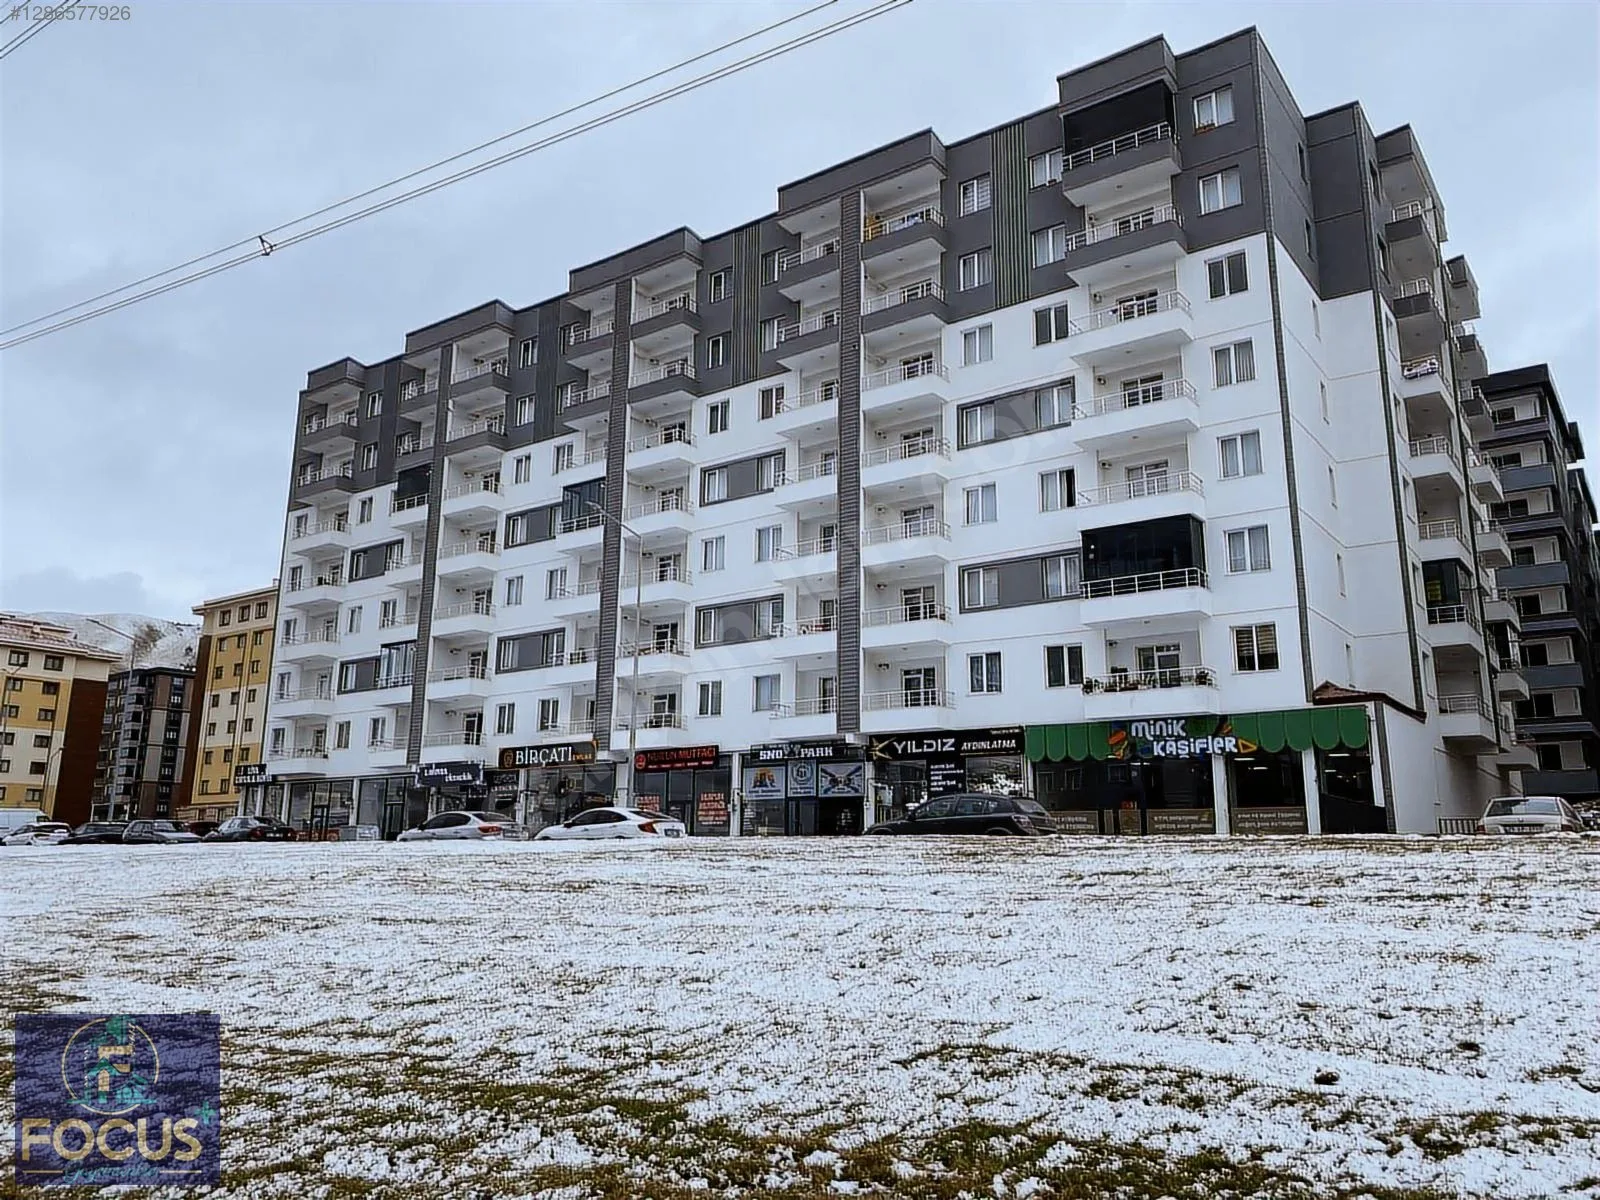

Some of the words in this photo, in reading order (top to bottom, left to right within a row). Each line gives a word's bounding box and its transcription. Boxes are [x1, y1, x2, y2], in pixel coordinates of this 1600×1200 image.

[893, 738, 956, 754] YILDIZ
[961, 739, 1017, 751] AYDINLATMA
[515, 746, 572, 768] BİRÇATI
